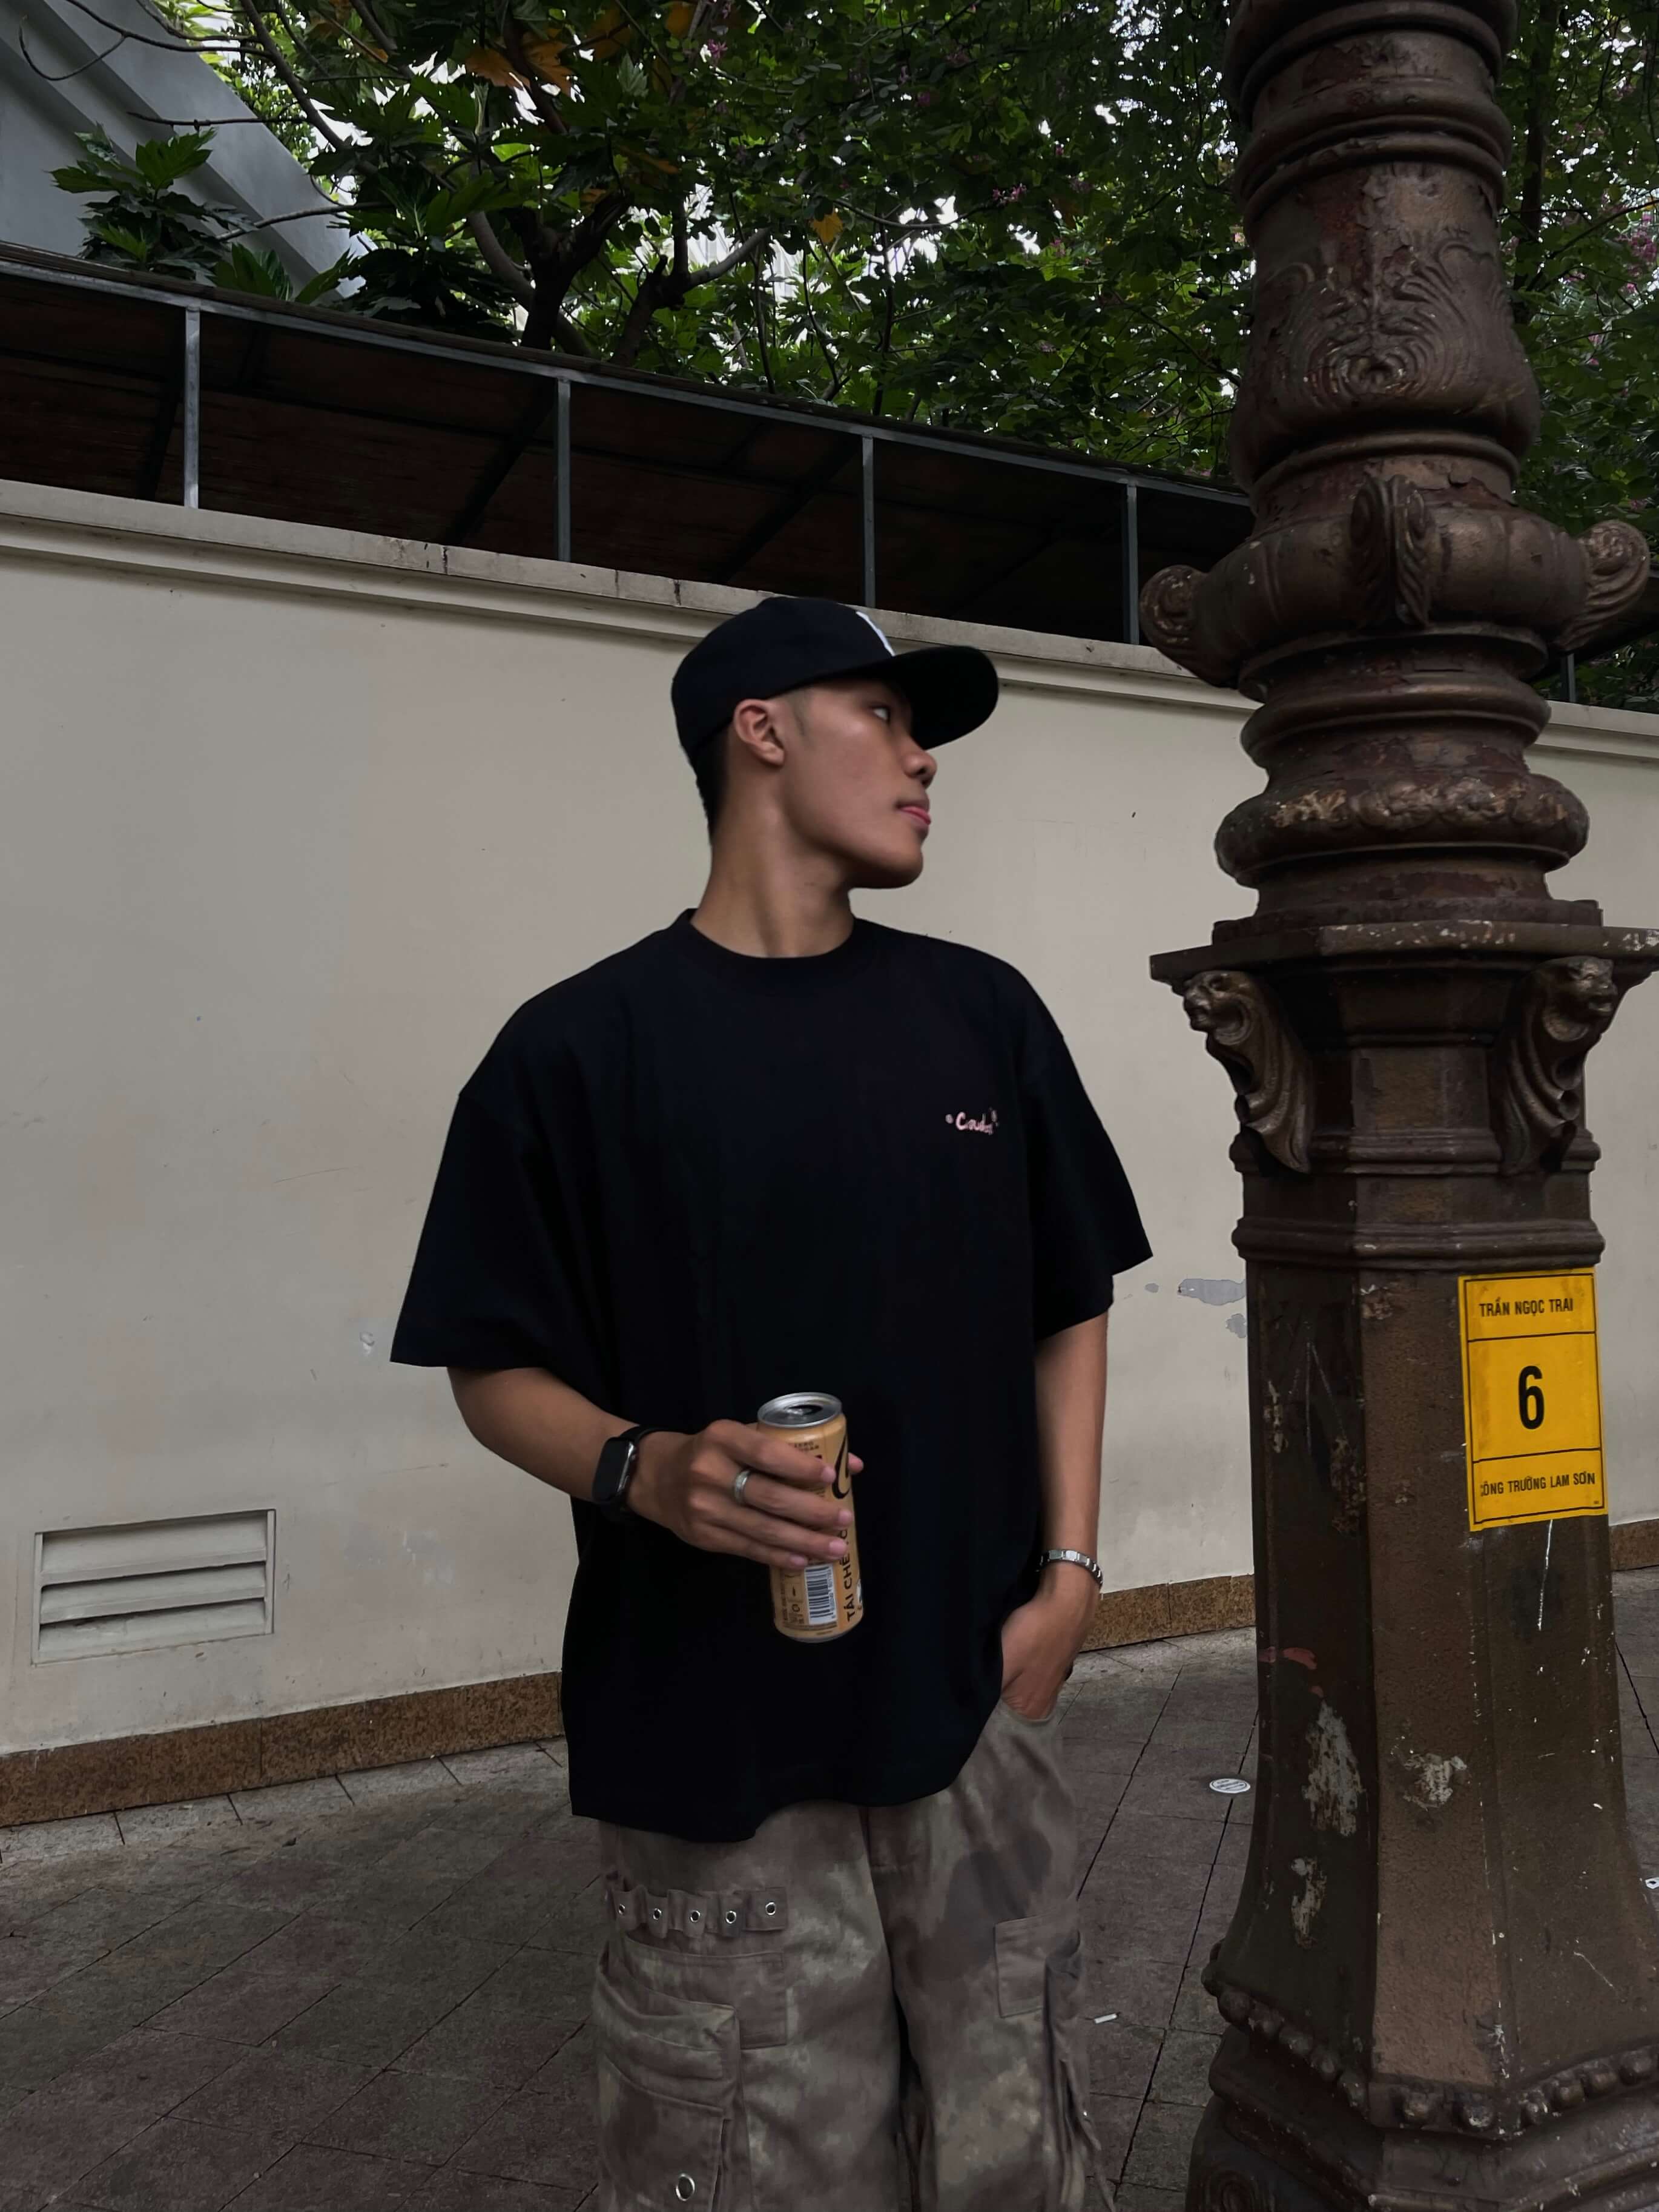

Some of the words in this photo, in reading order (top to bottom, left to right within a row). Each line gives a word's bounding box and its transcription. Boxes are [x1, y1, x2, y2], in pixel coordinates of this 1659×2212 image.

[1515, 1299, 1545, 1316] NGỌC
[1549, 1298, 1574, 1312] TRAI
[1518, 1365, 1545, 1430] 6
[1550, 1474, 1569, 1488] LAM
[1573, 1471, 1595, 1485] SƠN
